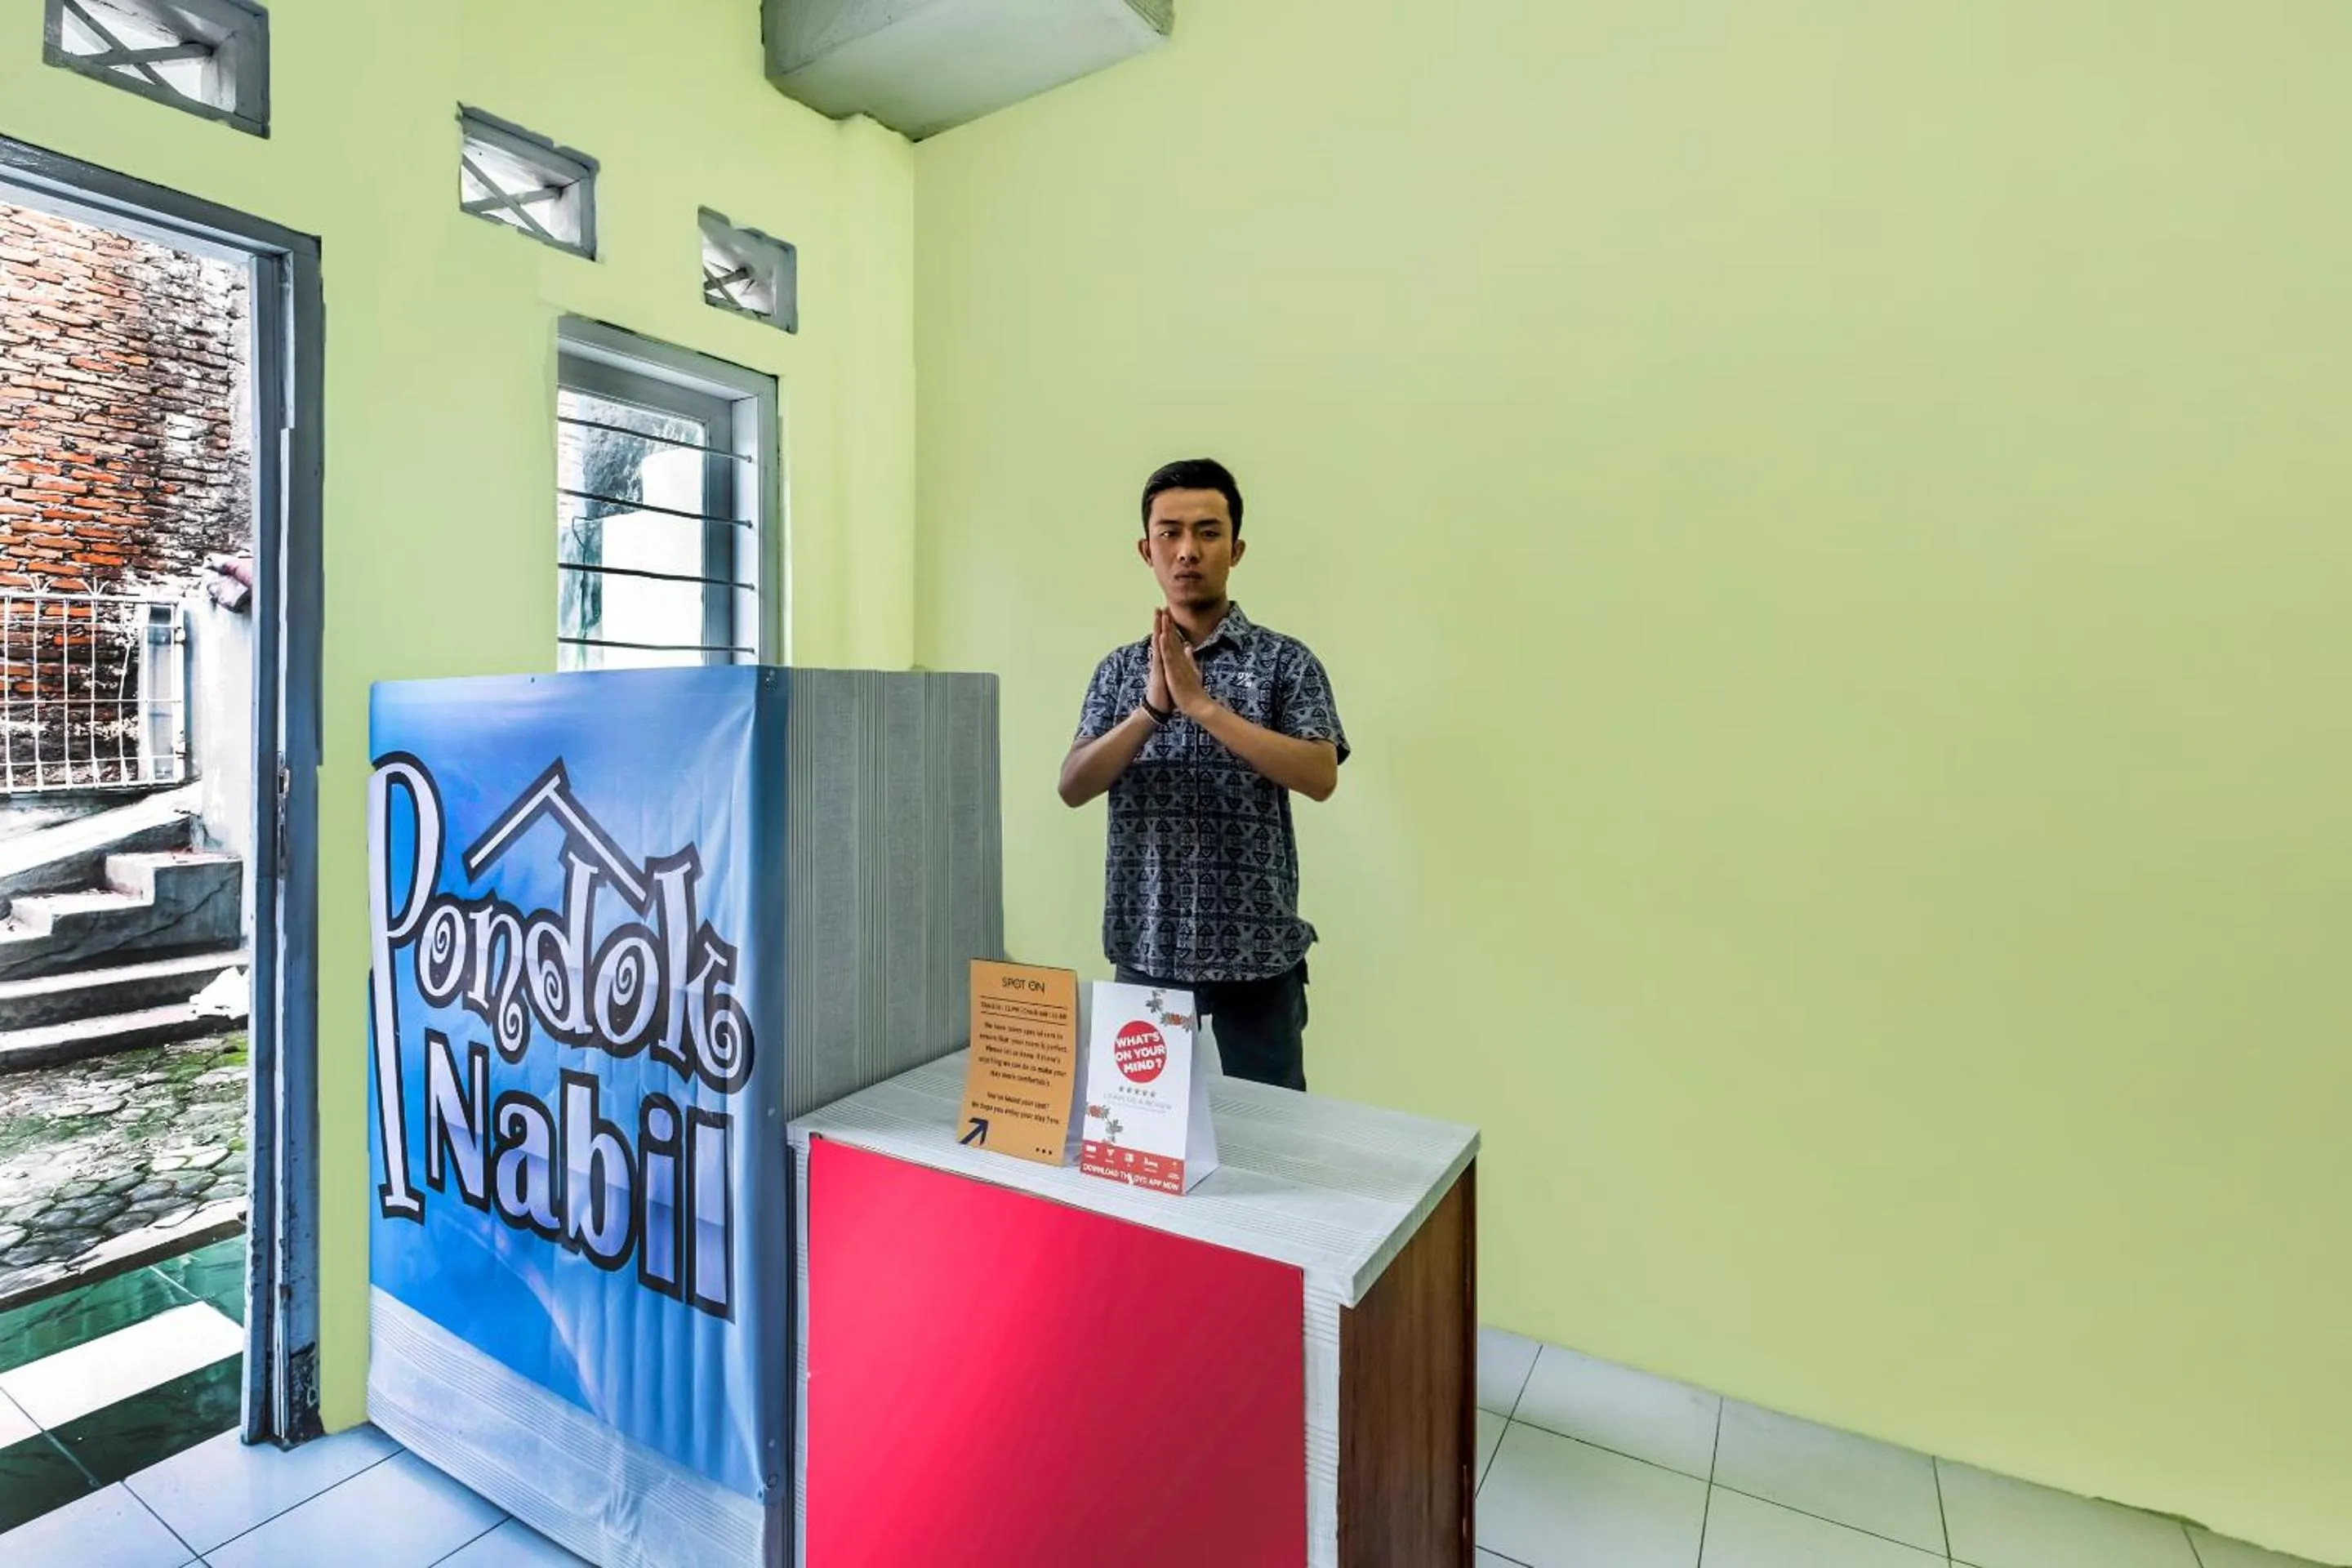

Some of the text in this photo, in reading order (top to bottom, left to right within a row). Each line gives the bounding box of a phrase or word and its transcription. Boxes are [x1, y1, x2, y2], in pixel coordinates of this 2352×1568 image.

[368, 751, 755, 1225] Pondok
[1001, 977, 1045, 994] SPOT ON
[1116, 1031, 1160, 1048] WHAT'S
[1116, 1045, 1166, 1061] ON YOUR
[425, 1027, 735, 1325] Nabil
[1082, 1162, 1119, 1176] DOWNLOAD
[1120, 1170, 1133, 1182] TH
[1163, 1181, 1179, 1191] NOW
